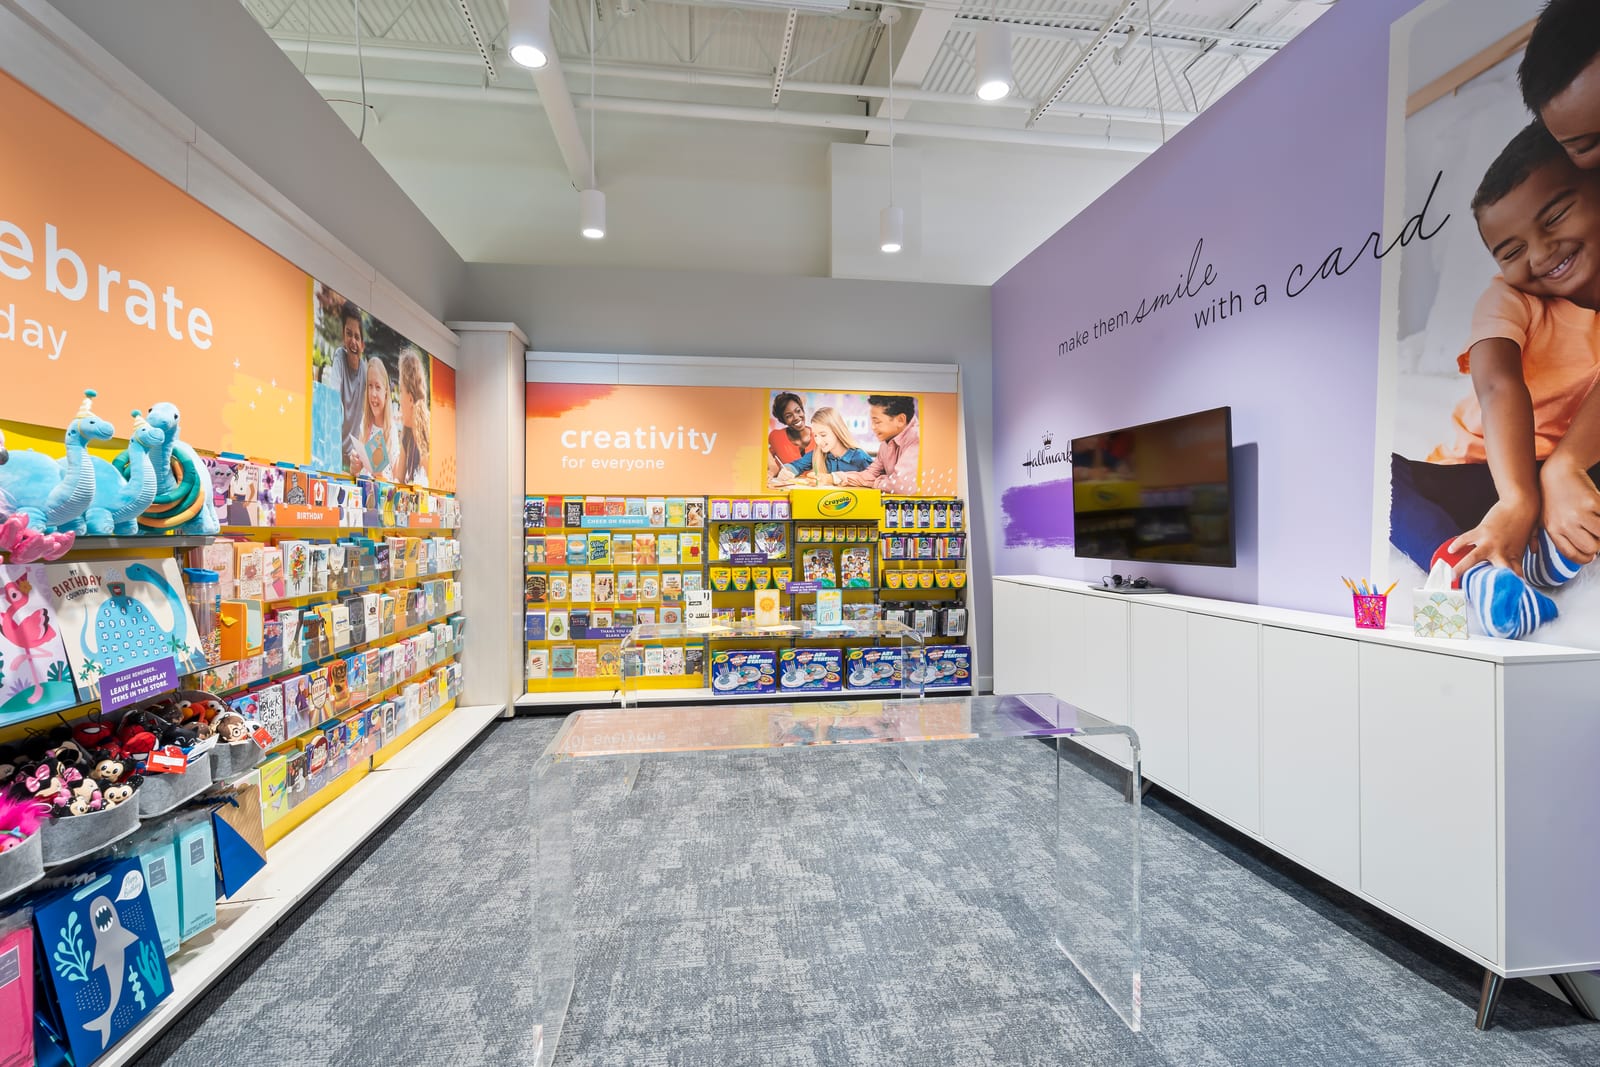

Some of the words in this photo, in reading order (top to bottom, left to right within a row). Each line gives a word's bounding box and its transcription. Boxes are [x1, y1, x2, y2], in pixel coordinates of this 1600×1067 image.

[1194, 290, 1242, 329] with
[1254, 284, 1268, 306] a
[1286, 170, 1450, 297] card
[1058, 327, 1089, 356] make
[1093, 309, 1129, 340] them
[1131, 238, 1217, 326] smile
[560, 425, 717, 455] creativity
[562, 455, 585, 469] for
[591, 457, 665, 471] everyone
[1022, 440, 1072, 478] Hallmark
[296, 511, 324, 520] BIRTHDAY
[52, 575, 102, 597] BIRTHDAY
[110, 683, 129, 696] LEAVE
[130, 679, 141, 689] ALL
[142, 671, 167, 684] DISPLAY
[115, 673, 132, 683] PLEASE
[111, 693, 129, 704] ITEMS
[129, 690, 137, 698] IN
[137, 686, 149, 695] THE
[150, 680, 169, 691] STORE.
